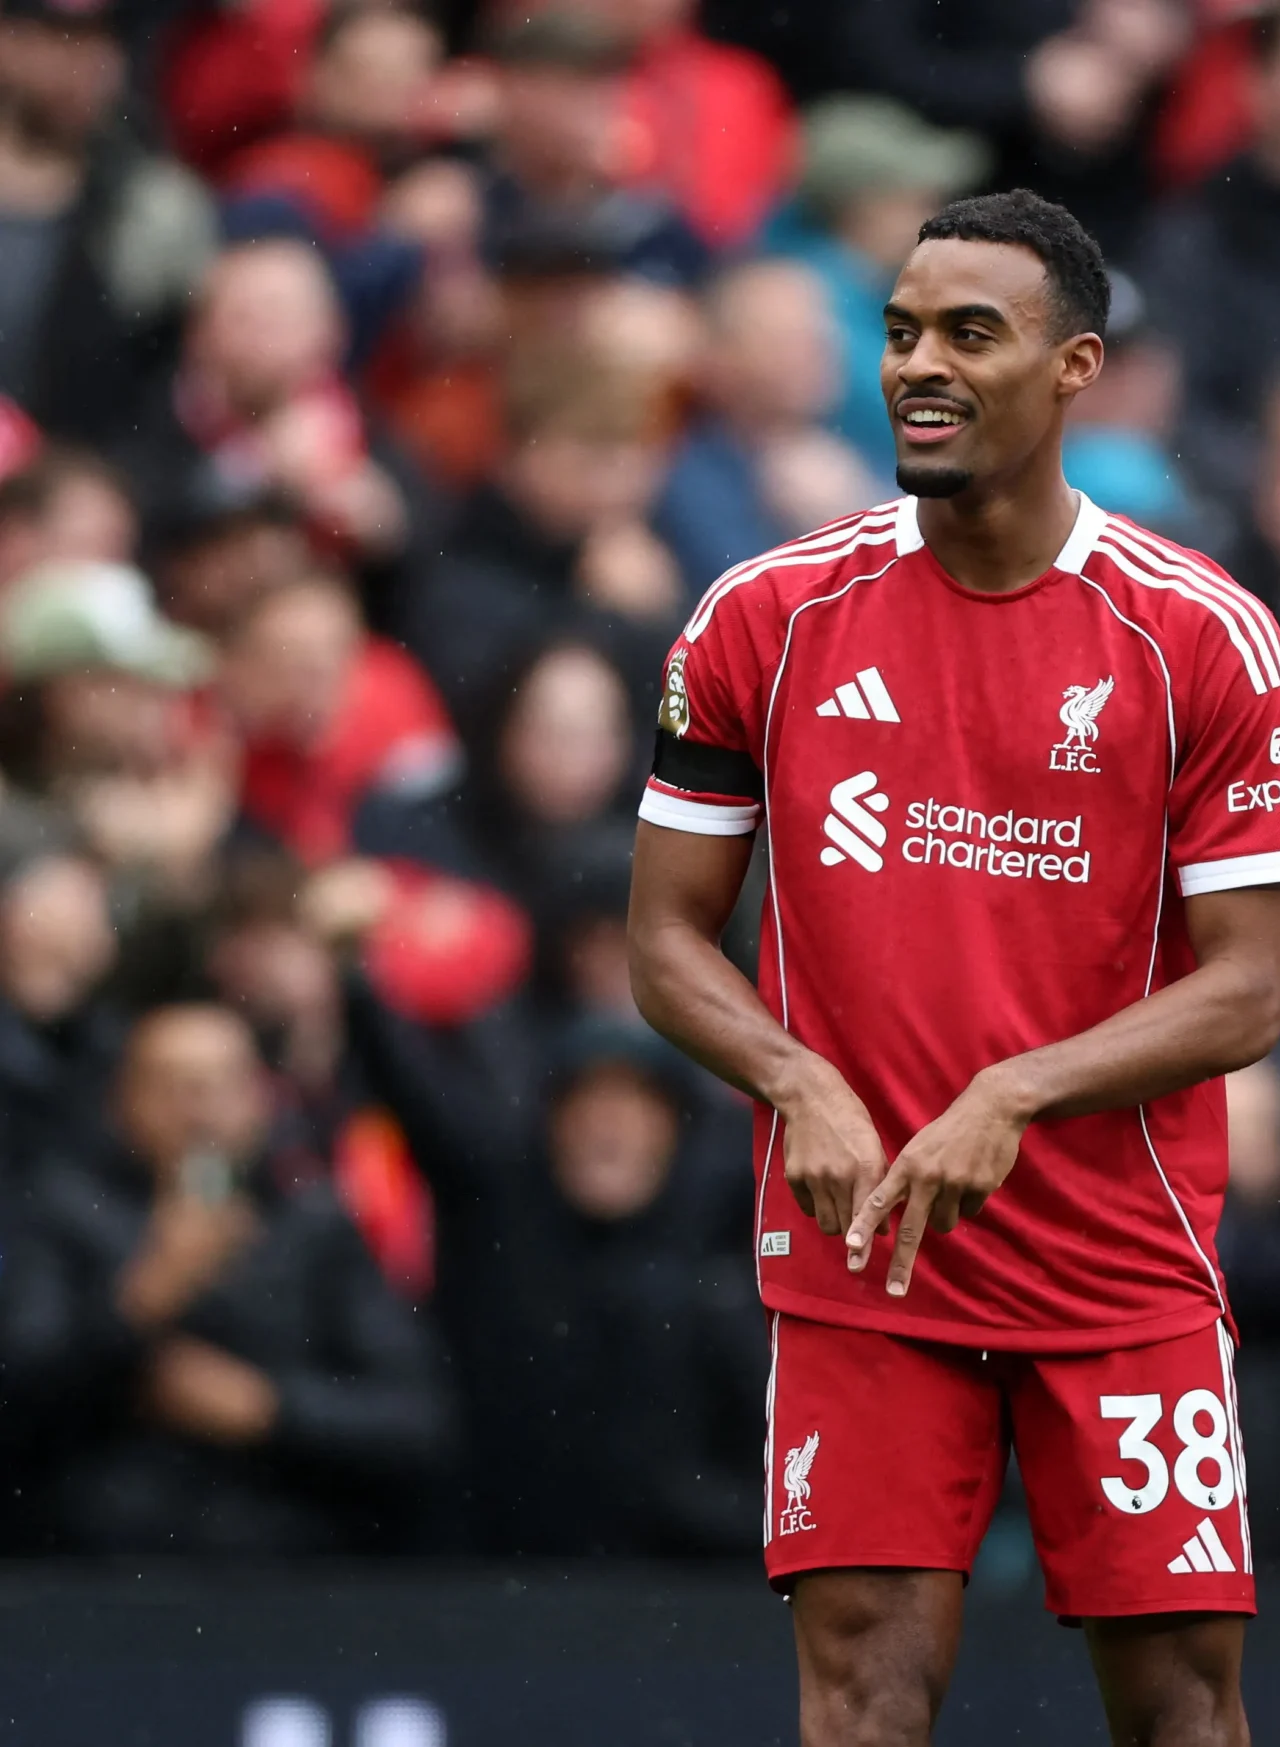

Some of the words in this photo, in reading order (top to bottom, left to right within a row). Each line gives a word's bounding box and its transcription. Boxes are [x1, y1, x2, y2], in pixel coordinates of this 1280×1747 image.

[905, 797, 1082, 848] standard
[902, 831, 1091, 883] chartered
[1099, 1388, 1236, 1514] 38
